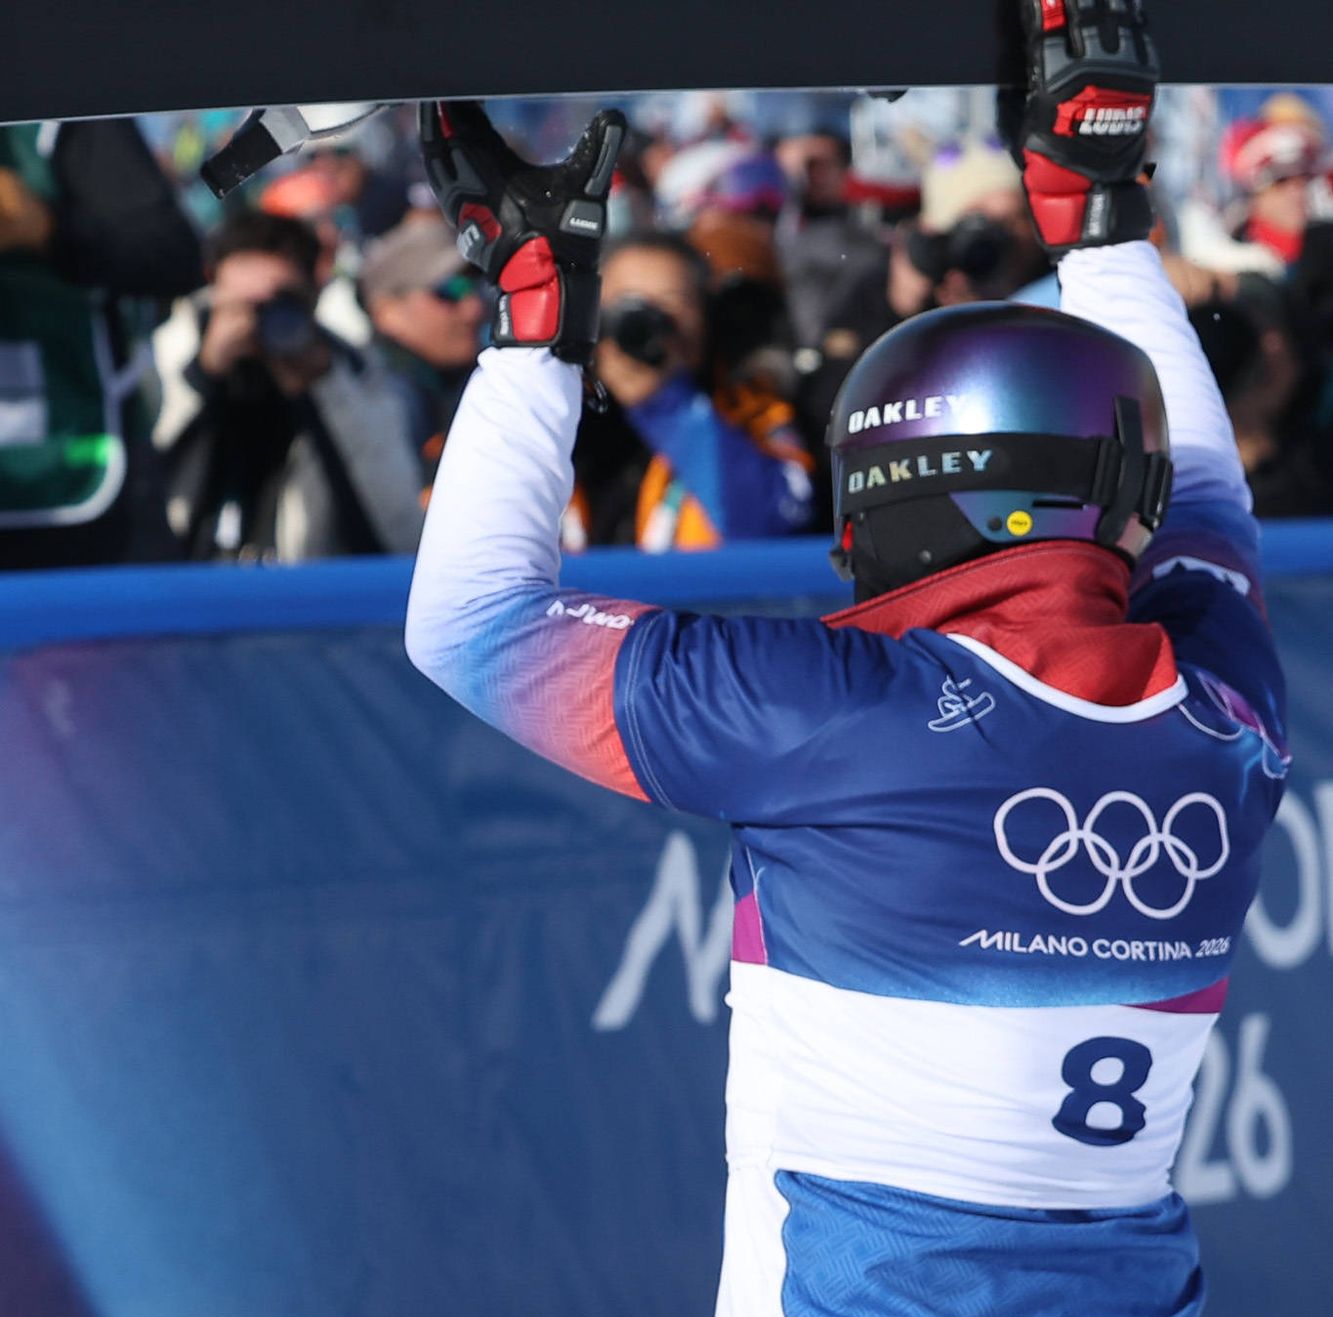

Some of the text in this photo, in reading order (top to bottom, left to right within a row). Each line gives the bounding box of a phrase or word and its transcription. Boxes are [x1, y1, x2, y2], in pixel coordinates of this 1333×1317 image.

[848, 395, 967, 434] OAKLEY
[848, 450, 992, 494] OAKLEY
[959, 929, 1230, 961] MILANO CORTINA 2026
[1051, 1035, 1153, 1146] 8
[1174, 1013, 1293, 1199] 26
